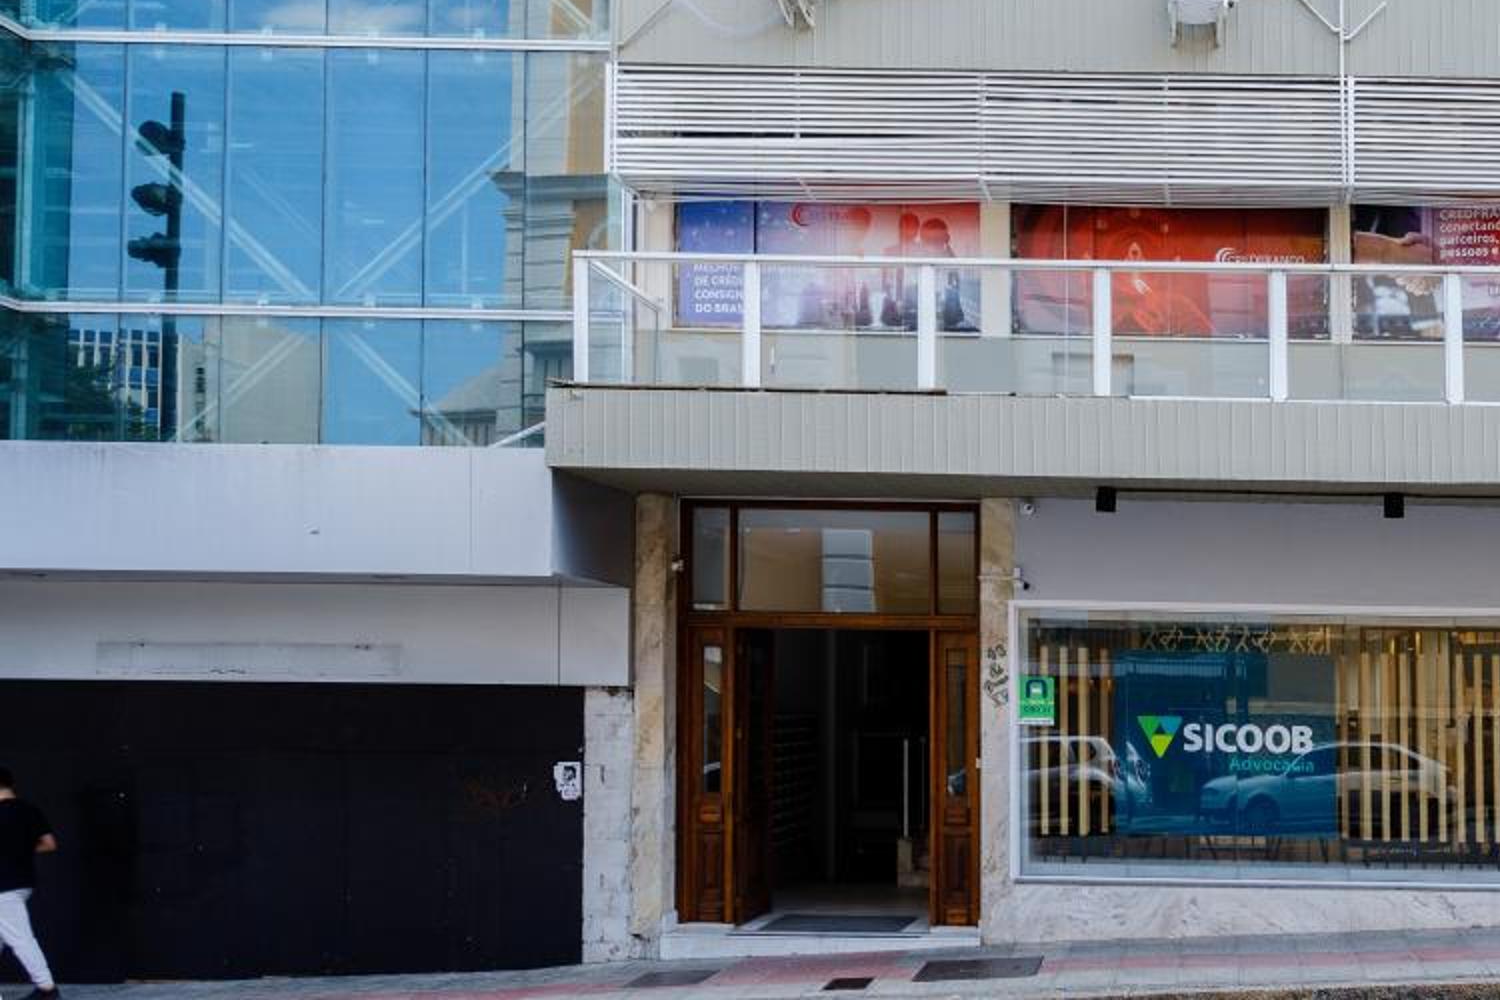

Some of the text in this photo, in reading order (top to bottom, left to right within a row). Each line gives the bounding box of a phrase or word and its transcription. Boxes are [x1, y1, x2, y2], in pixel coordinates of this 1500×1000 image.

[1440, 246, 1489, 259] pessoas
[1491, 246, 1499, 255] e
[1182, 723, 1314, 754] SICOOB
